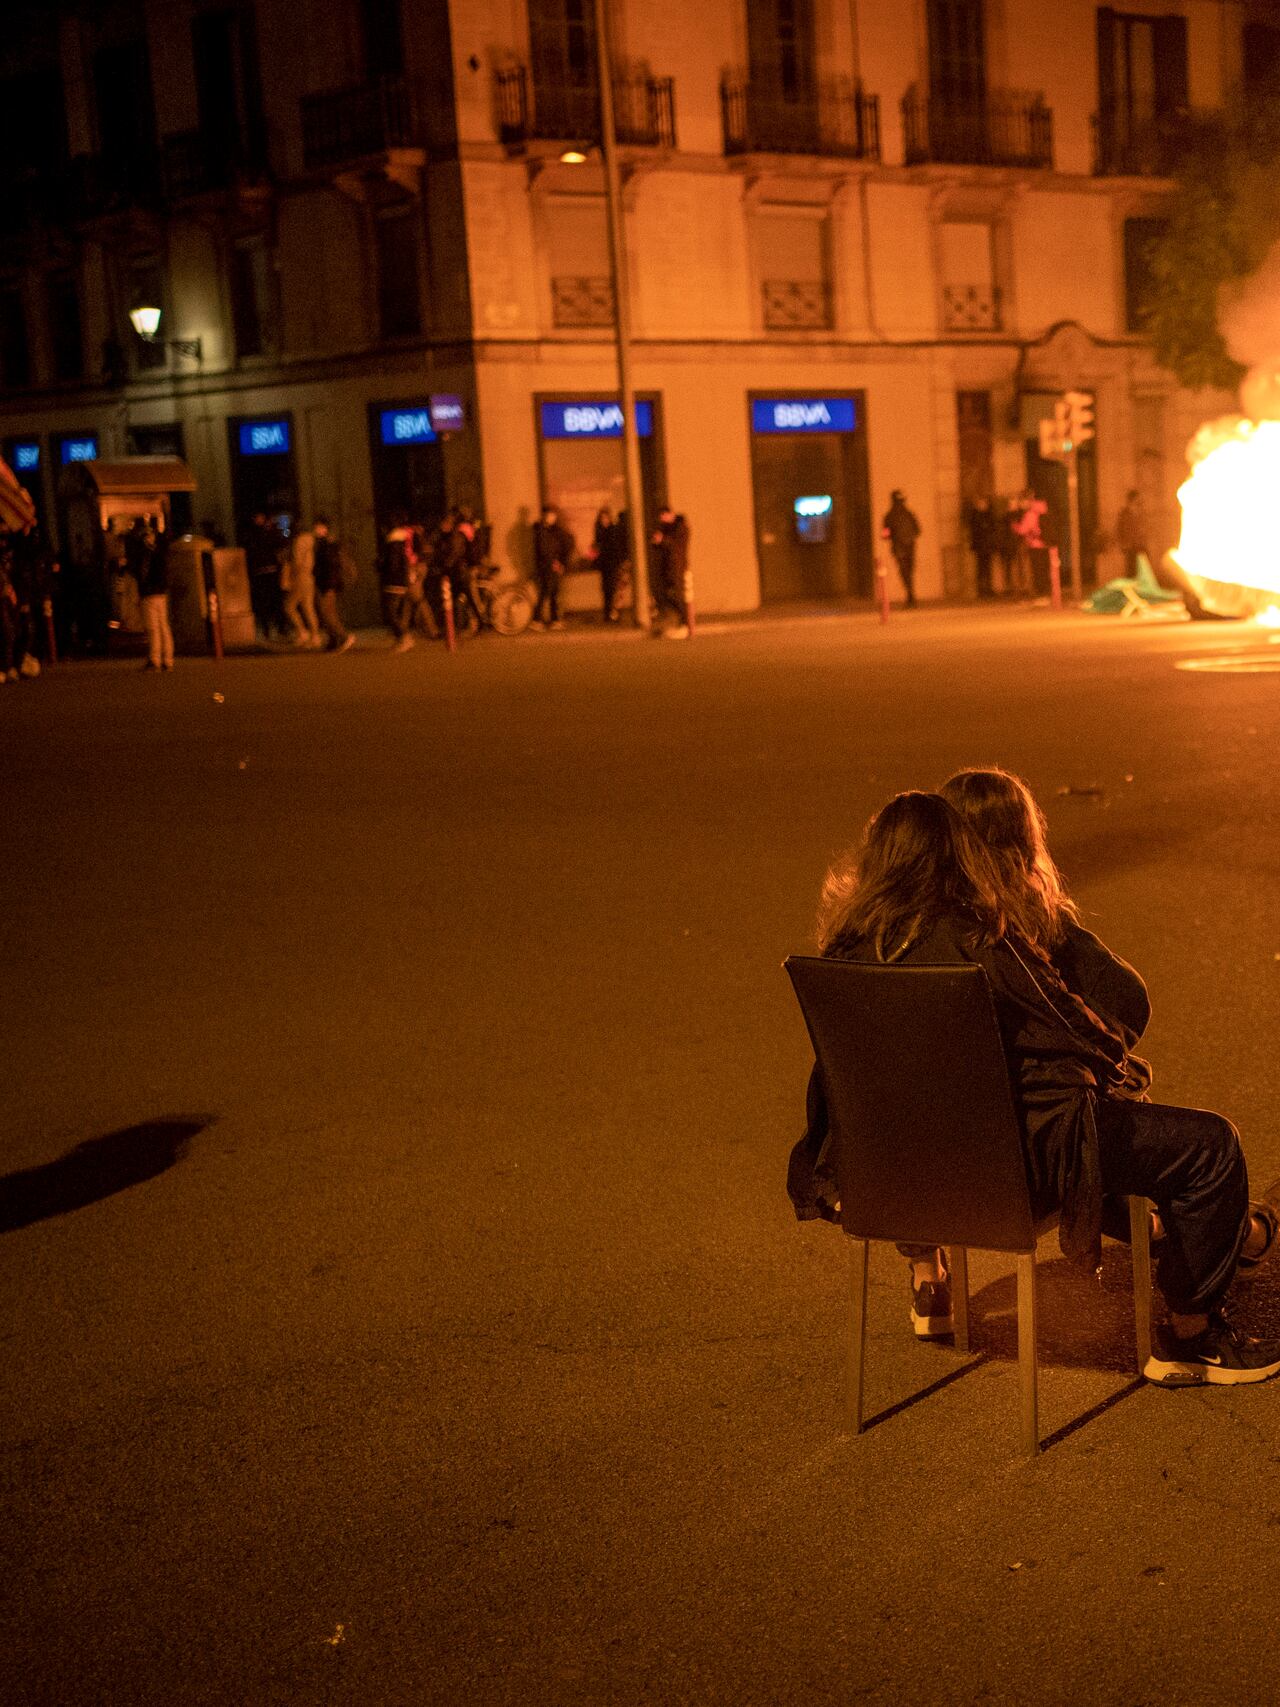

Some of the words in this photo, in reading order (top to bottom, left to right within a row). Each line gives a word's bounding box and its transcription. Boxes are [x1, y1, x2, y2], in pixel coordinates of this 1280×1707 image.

[394, 412, 432, 439] BBVA
[564, 406, 625, 433] BBVA
[774, 402, 832, 428] BBVA
[252, 424, 284, 450] BBVA
